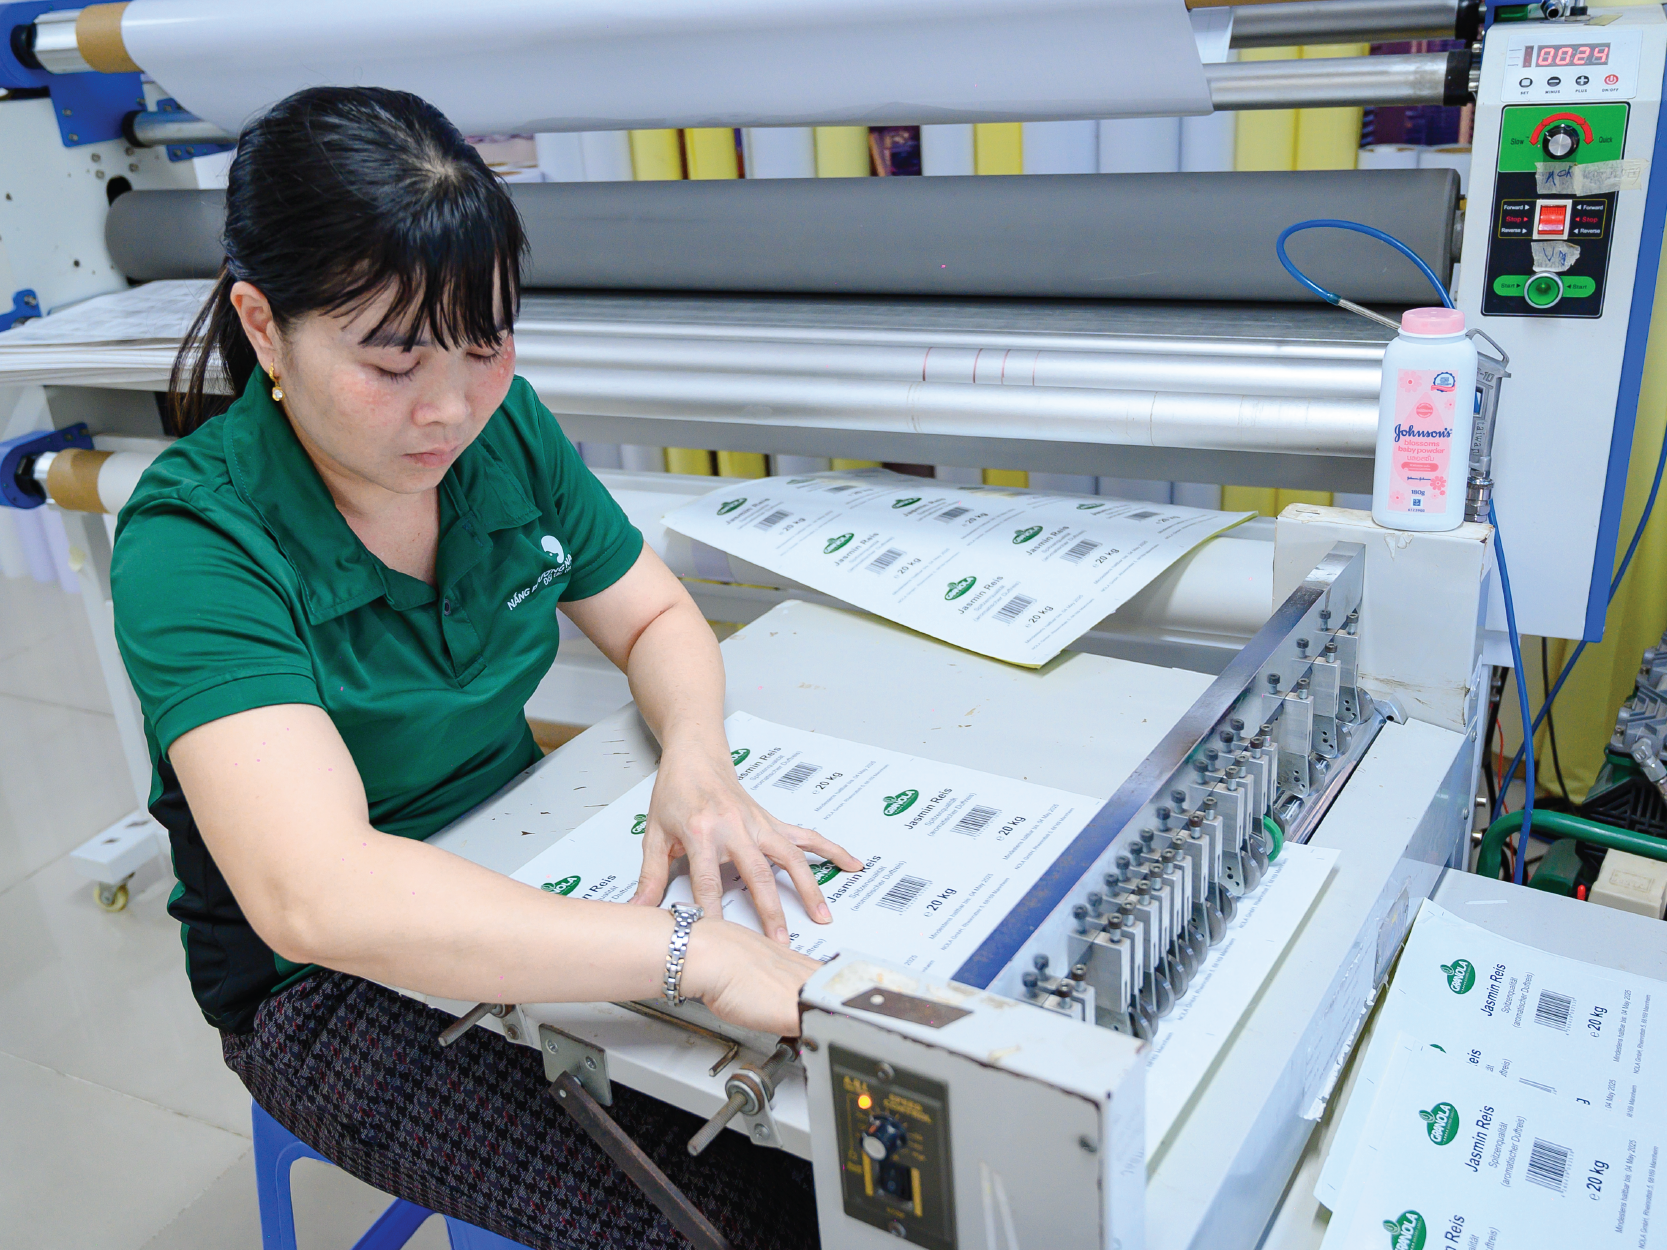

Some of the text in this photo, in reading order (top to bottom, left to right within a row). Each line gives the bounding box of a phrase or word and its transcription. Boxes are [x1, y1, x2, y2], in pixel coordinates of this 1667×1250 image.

[1537, 47, 1609, 66] 0024
[1394, 424, 1452, 442] Johnson's
[1471, 421, 1485, 456] taiwan
[1398, 446, 1445, 455] baby powder
[1025, 535, 1053, 556] Jasmin
[834, 545, 861, 566] Jasmin
[1095, 548, 1120, 564] 20 kg
[897, 557, 921, 574] 20 kg
[958, 576, 1003, 615] Jasmin Reis
[1028, 605, 1054, 623] 20 kg
[738, 761, 763, 780] asmin
[760, 747, 781, 761] Reis
[815, 781, 829, 790] 20
[826, 772, 843, 782] kg
[904, 788, 952, 830] Jasmin Reis
[998, 826, 1013, 836] 20
[1007, 816, 1026, 826] kg
[589, 874, 617, 893] Reis
[827, 873, 862, 904] Jasmin
[926, 900, 942, 911] 20
[937, 888, 957, 899] kg
[1451, 961, 1468, 991] GRANOLA
[1480, 963, 1506, 1017] Jasmin Reis
[1624, 989, 1632, 1000] 2025
[1589, 1006, 1608, 1018] kg
[1622, 1000, 1631, 1009] May
[1587, 1018, 1602, 1031] 20
[1468, 1049, 1482, 1066] eis
[1608, 1079, 1616, 1091] 2025
[1606, 1091, 1615, 1101] May
[1430, 1104, 1451, 1142] GRANOLA
[1464, 1105, 1495, 1173] Jasmin Reis
[1488, 1121, 1508, 1169] Spitzenqualität
[1628, 1139, 1637, 1153] 2025
[1500, 1115, 1527, 1188] (aromatischer Duftreis)
[1626, 1153, 1636, 1165] May
[1589, 1159, 1609, 1176] kg
[1586, 1176, 1602, 1193] 20
[1615, 1202, 1627, 1233] Mindestens
[1394, 1212, 1418, 1250] RANOLA
[1445, 1214, 1465, 1243] Reis
[1485, 1226, 1501, 1250] uftreis)
[1638, 1234, 1647, 1249] NOLA
